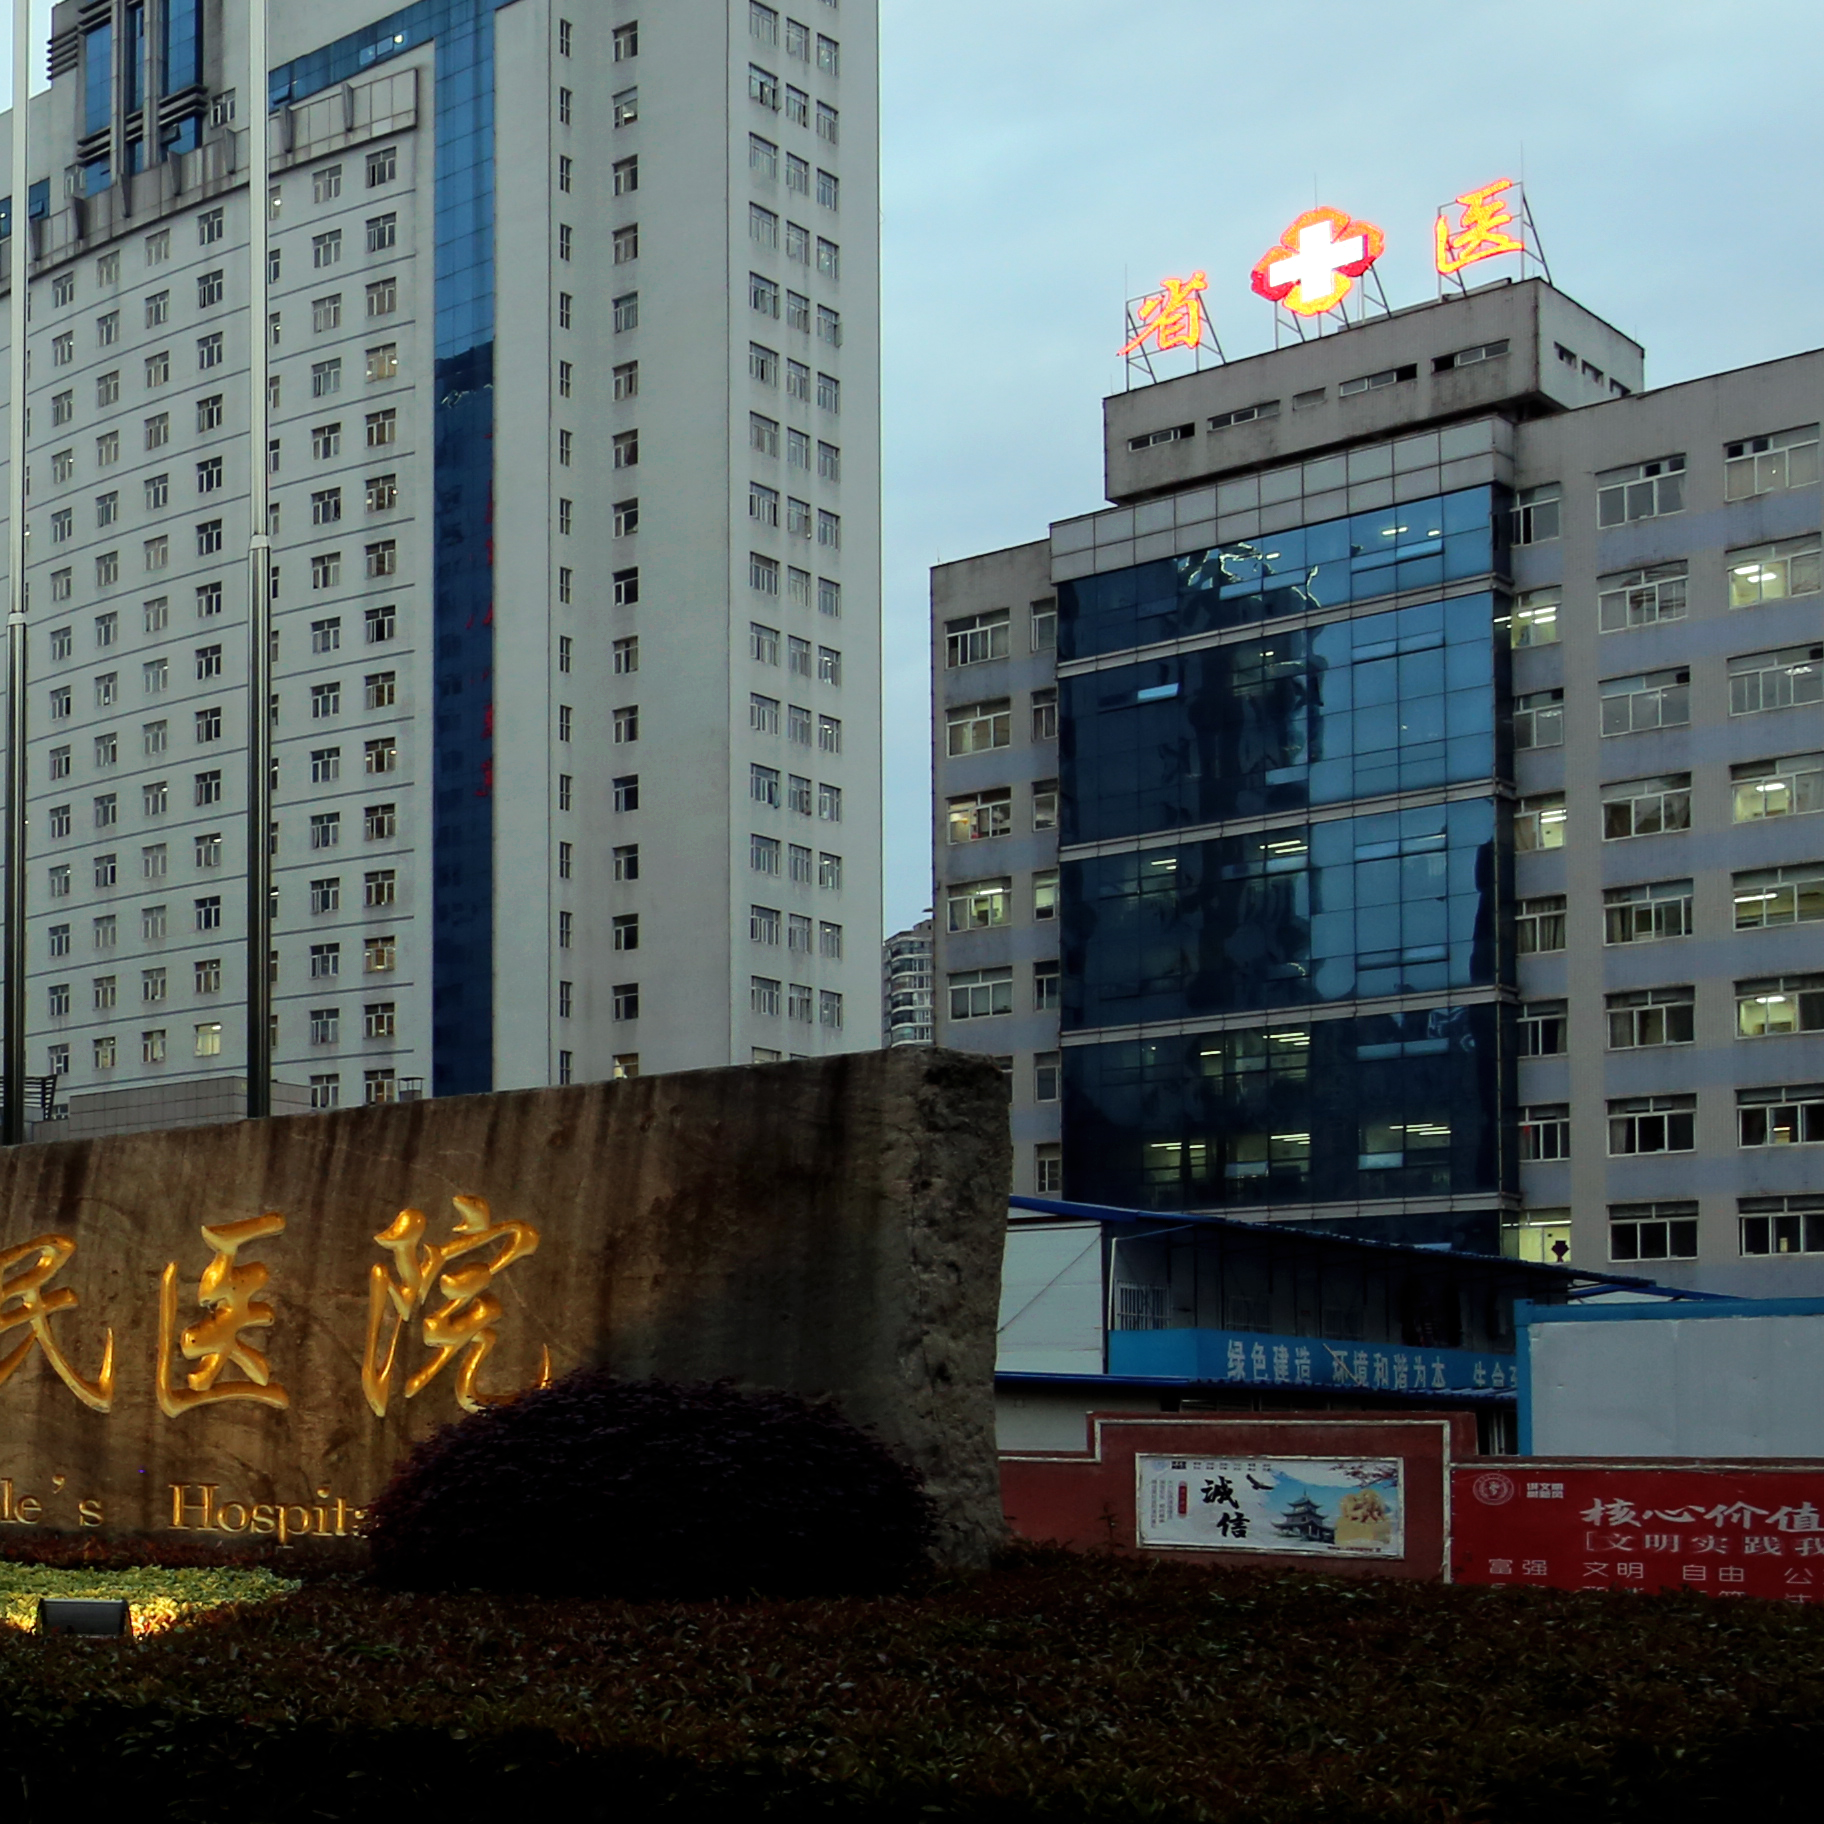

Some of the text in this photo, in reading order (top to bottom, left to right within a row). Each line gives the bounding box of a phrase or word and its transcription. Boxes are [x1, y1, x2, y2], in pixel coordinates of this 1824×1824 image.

[1116, 177, 1524, 357] 省 医
[168, 1482, 371, 1549] Hospit
[1579, 1498, 1824, 1533] 核心价值
[1583, 1561, 1644, 1580] 文明
[1682, 1564, 1745, 1583] 自由
